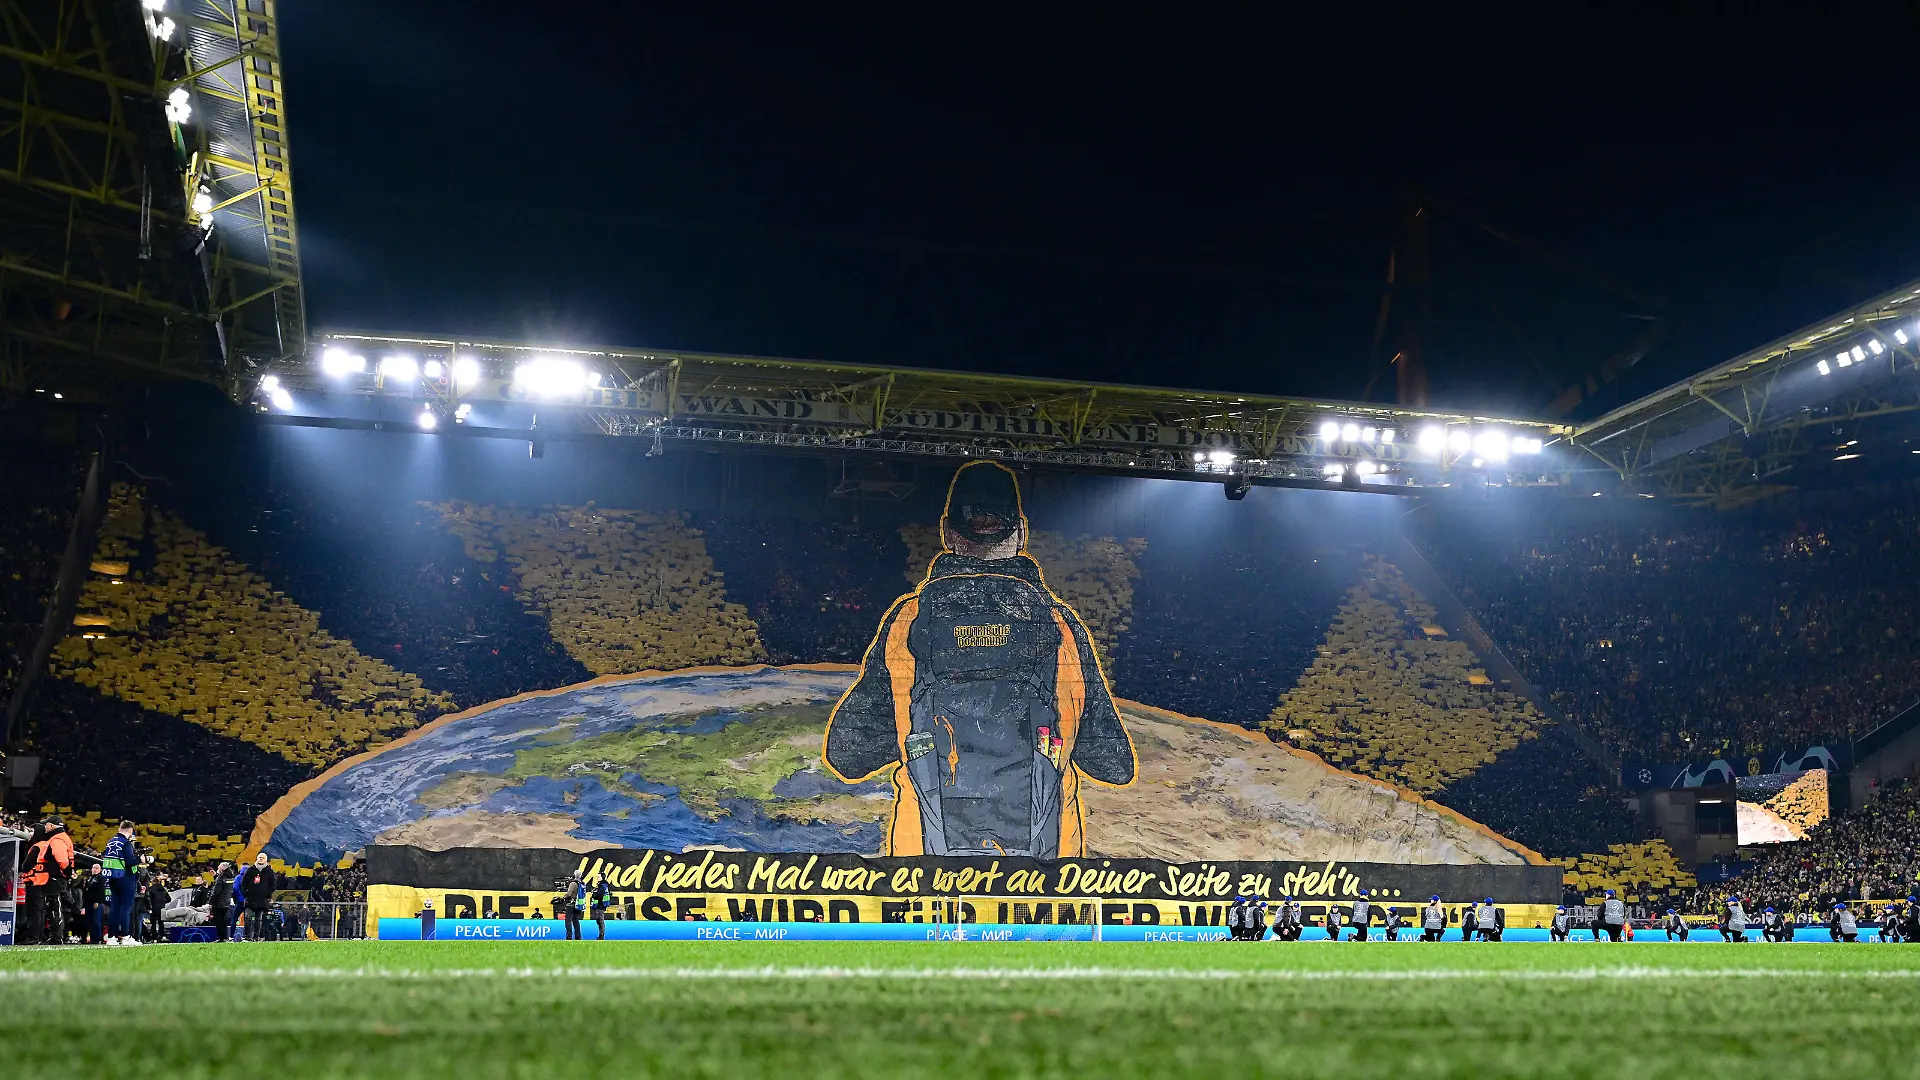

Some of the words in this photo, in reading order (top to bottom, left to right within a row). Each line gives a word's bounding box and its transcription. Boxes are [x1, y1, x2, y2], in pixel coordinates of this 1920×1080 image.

[680, 395, 813, 418] WAND
[578, 849, 654, 888] Und
[650, 850, 740, 894] jedes
[746, 854, 819, 892] Mal
[821, 865, 886, 892] war
[891, 867, 924, 893] es
[931, 860, 1004, 893] wert
[1005, 869, 1046, 894] an
[1054, 860, 1156, 895] Deiner
[1159, 864, 1232, 896] Seite
[1238, 873, 1271, 898] zu
[455, 925, 500, 939] PEACE
[516, 925, 551, 940] МИР
[697, 927, 740, 941] PEACE
[755, 928, 788, 942] МИР
[981, 930, 1013, 941] МИР
[1144, 931, 1184, 942] PEACE
